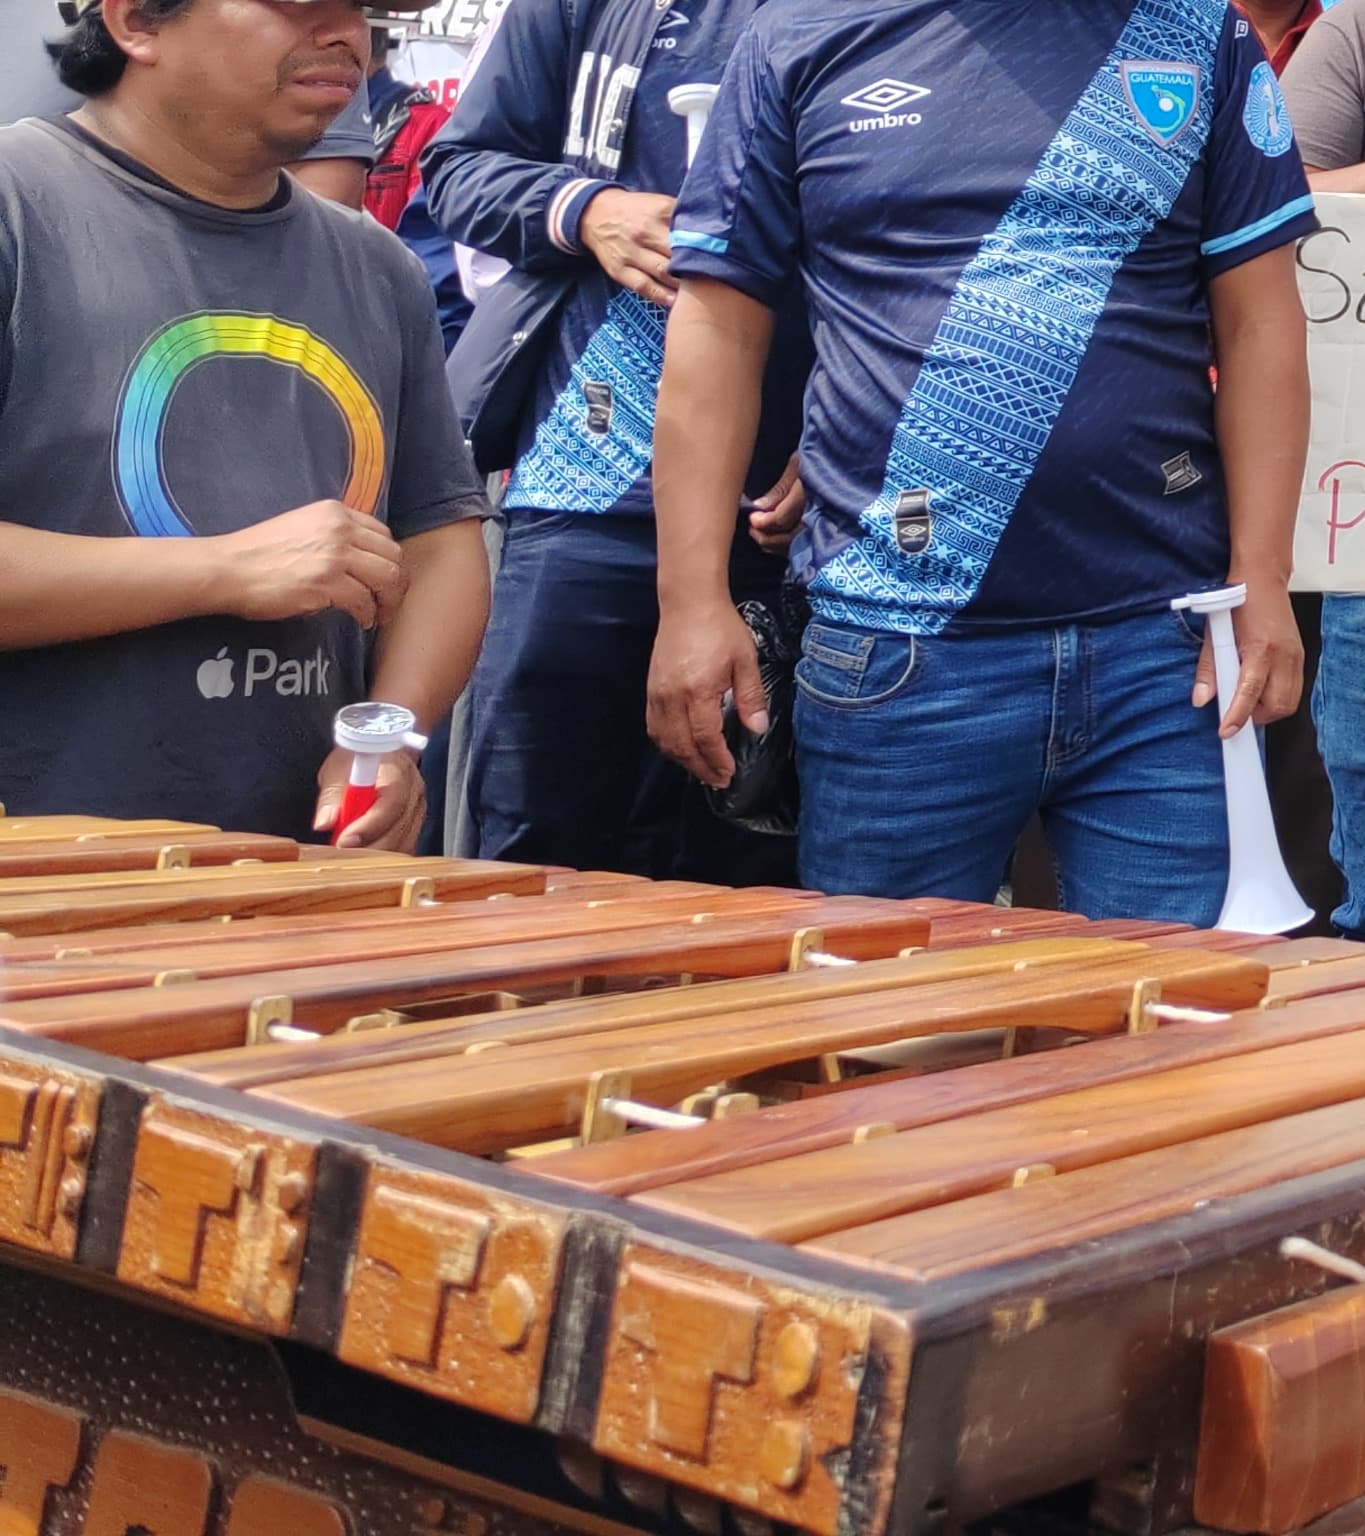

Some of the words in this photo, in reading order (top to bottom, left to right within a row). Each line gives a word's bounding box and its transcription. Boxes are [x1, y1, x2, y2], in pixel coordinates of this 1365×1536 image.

[1129, 71, 1193, 87] GUATEMALA
[848, 111, 922, 133] umbro
[243, 646, 330, 698] Park
